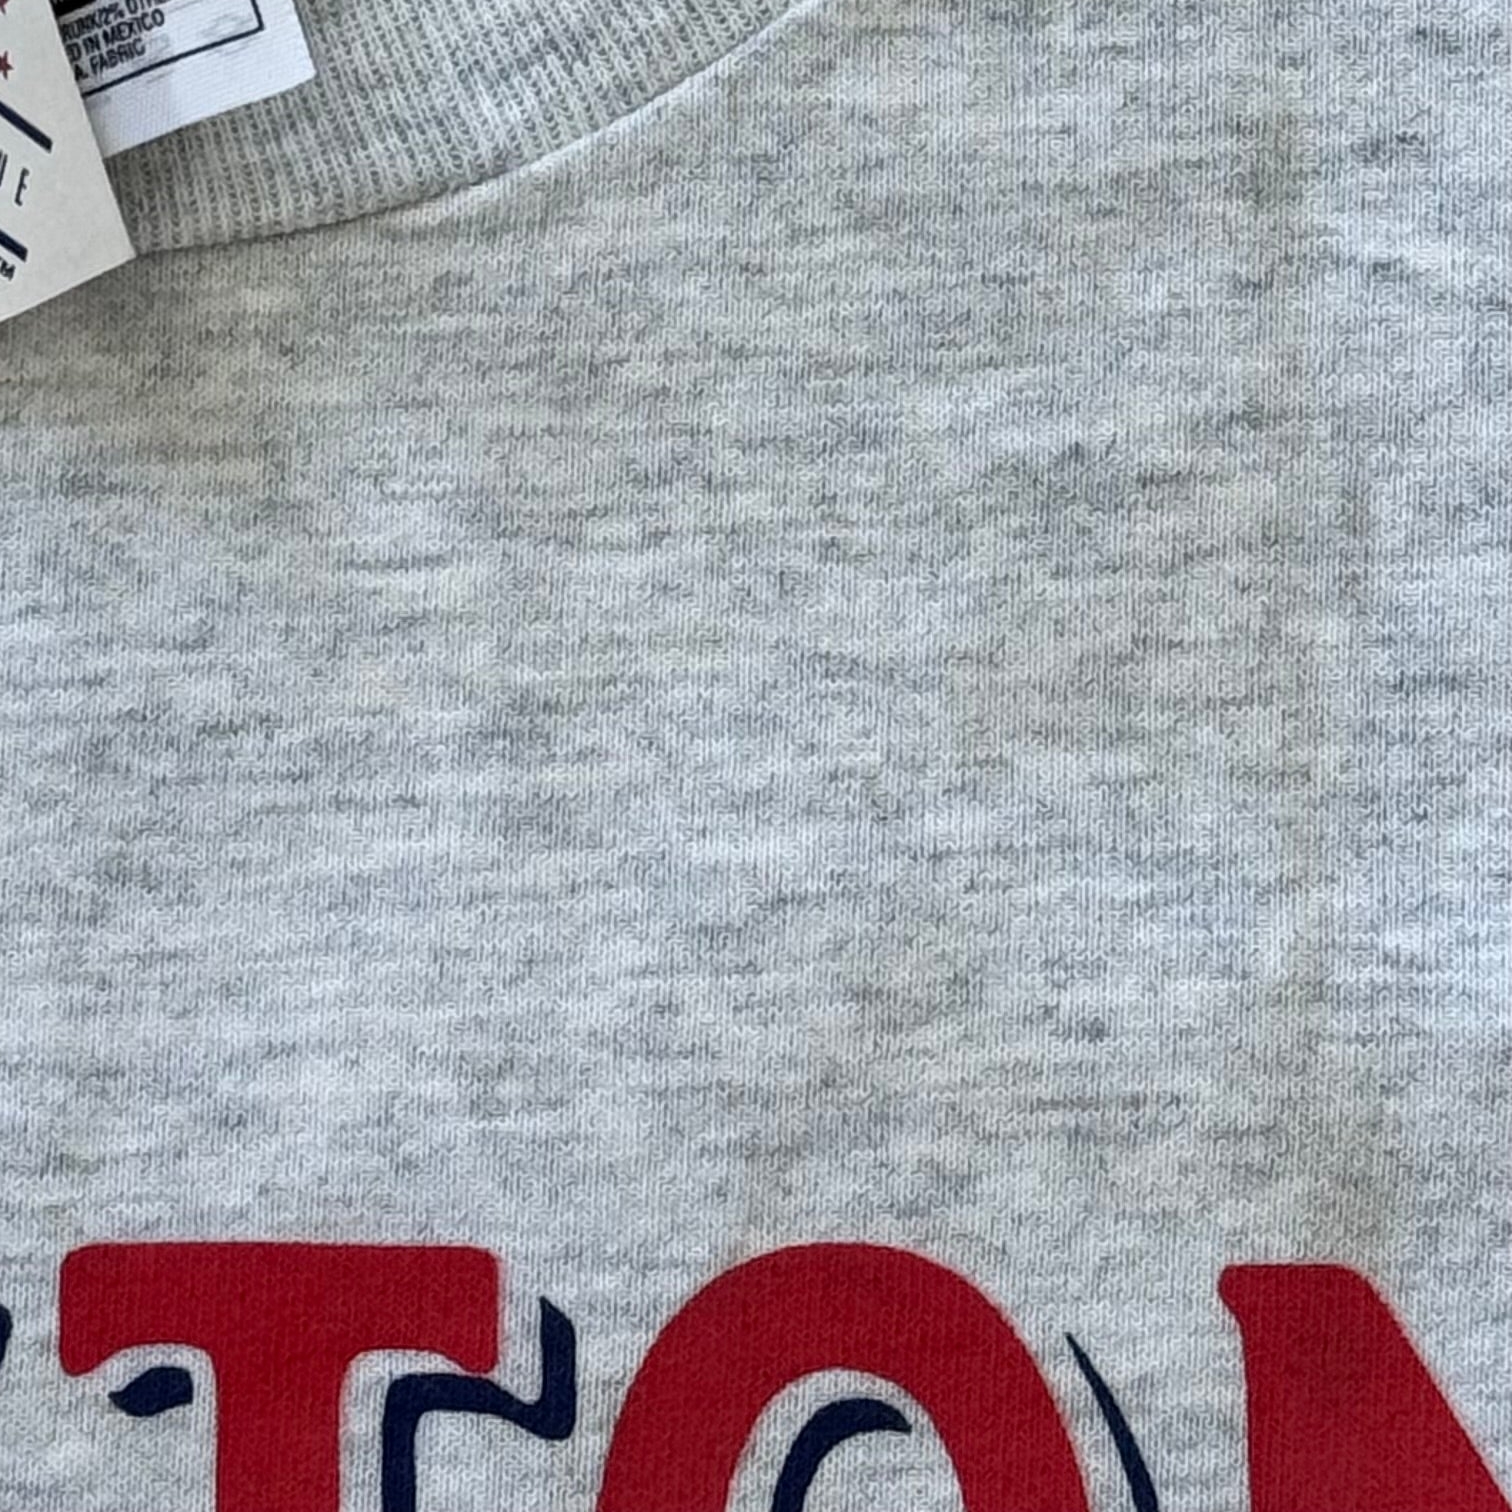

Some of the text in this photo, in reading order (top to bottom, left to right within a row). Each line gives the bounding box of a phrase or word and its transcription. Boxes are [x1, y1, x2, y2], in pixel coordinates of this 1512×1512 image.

[82, 34, 101, 53] IN
[98, 8, 165, 49] MEXICO
[88, 39, 147, 77] FABRIC
